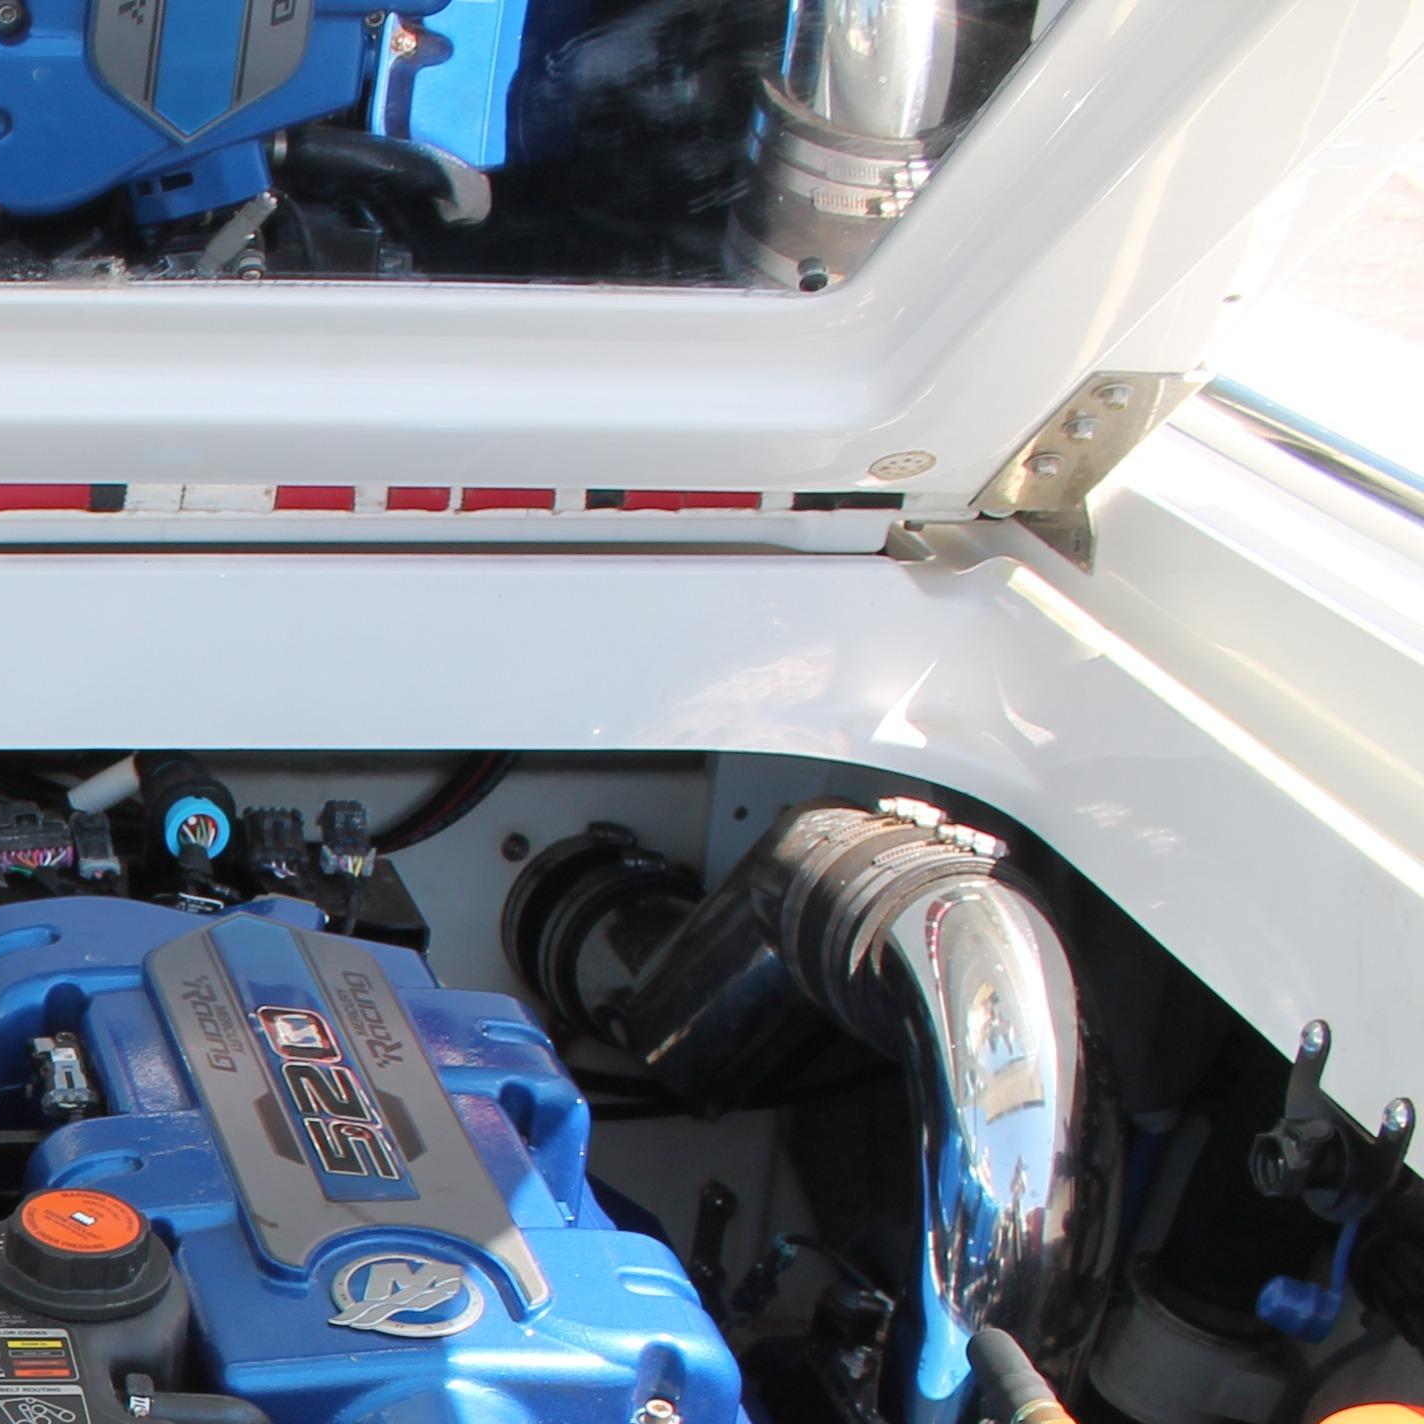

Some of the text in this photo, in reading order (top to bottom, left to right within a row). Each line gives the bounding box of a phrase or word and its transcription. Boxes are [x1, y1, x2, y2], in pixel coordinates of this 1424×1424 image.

[181, 975, 237, 1073] Racing
[342, 970, 403, 1068] Racing
[256, 1006, 401, 1180] 520
